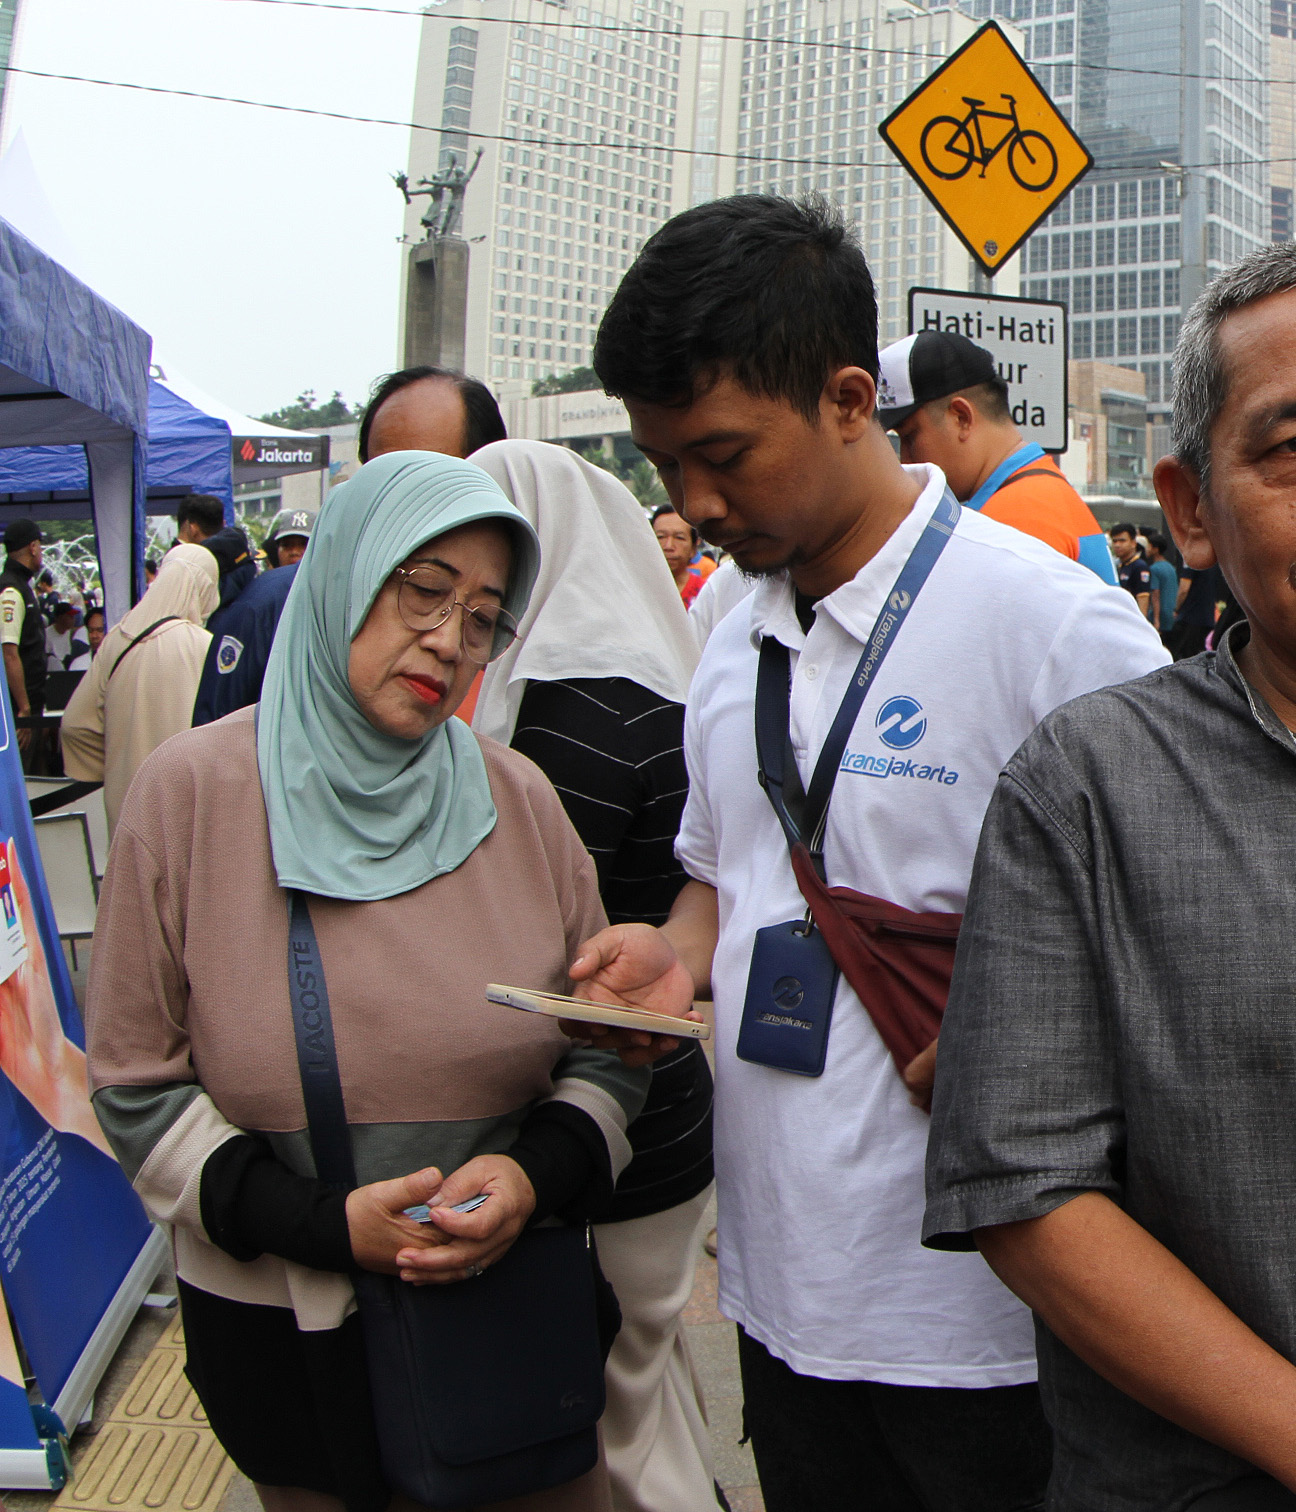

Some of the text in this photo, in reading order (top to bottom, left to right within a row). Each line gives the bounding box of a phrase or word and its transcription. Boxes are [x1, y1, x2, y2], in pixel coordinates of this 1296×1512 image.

[924, 309, 1054, 344] Hati-Hati
[256, 448, 313, 462] Jakarta
[291, 511, 308, 527] NY
[857, 611, 898, 688] transjakarta
[840, 748, 959, 785] transjakarta
[293, 941, 329, 1073] LACOSTE
